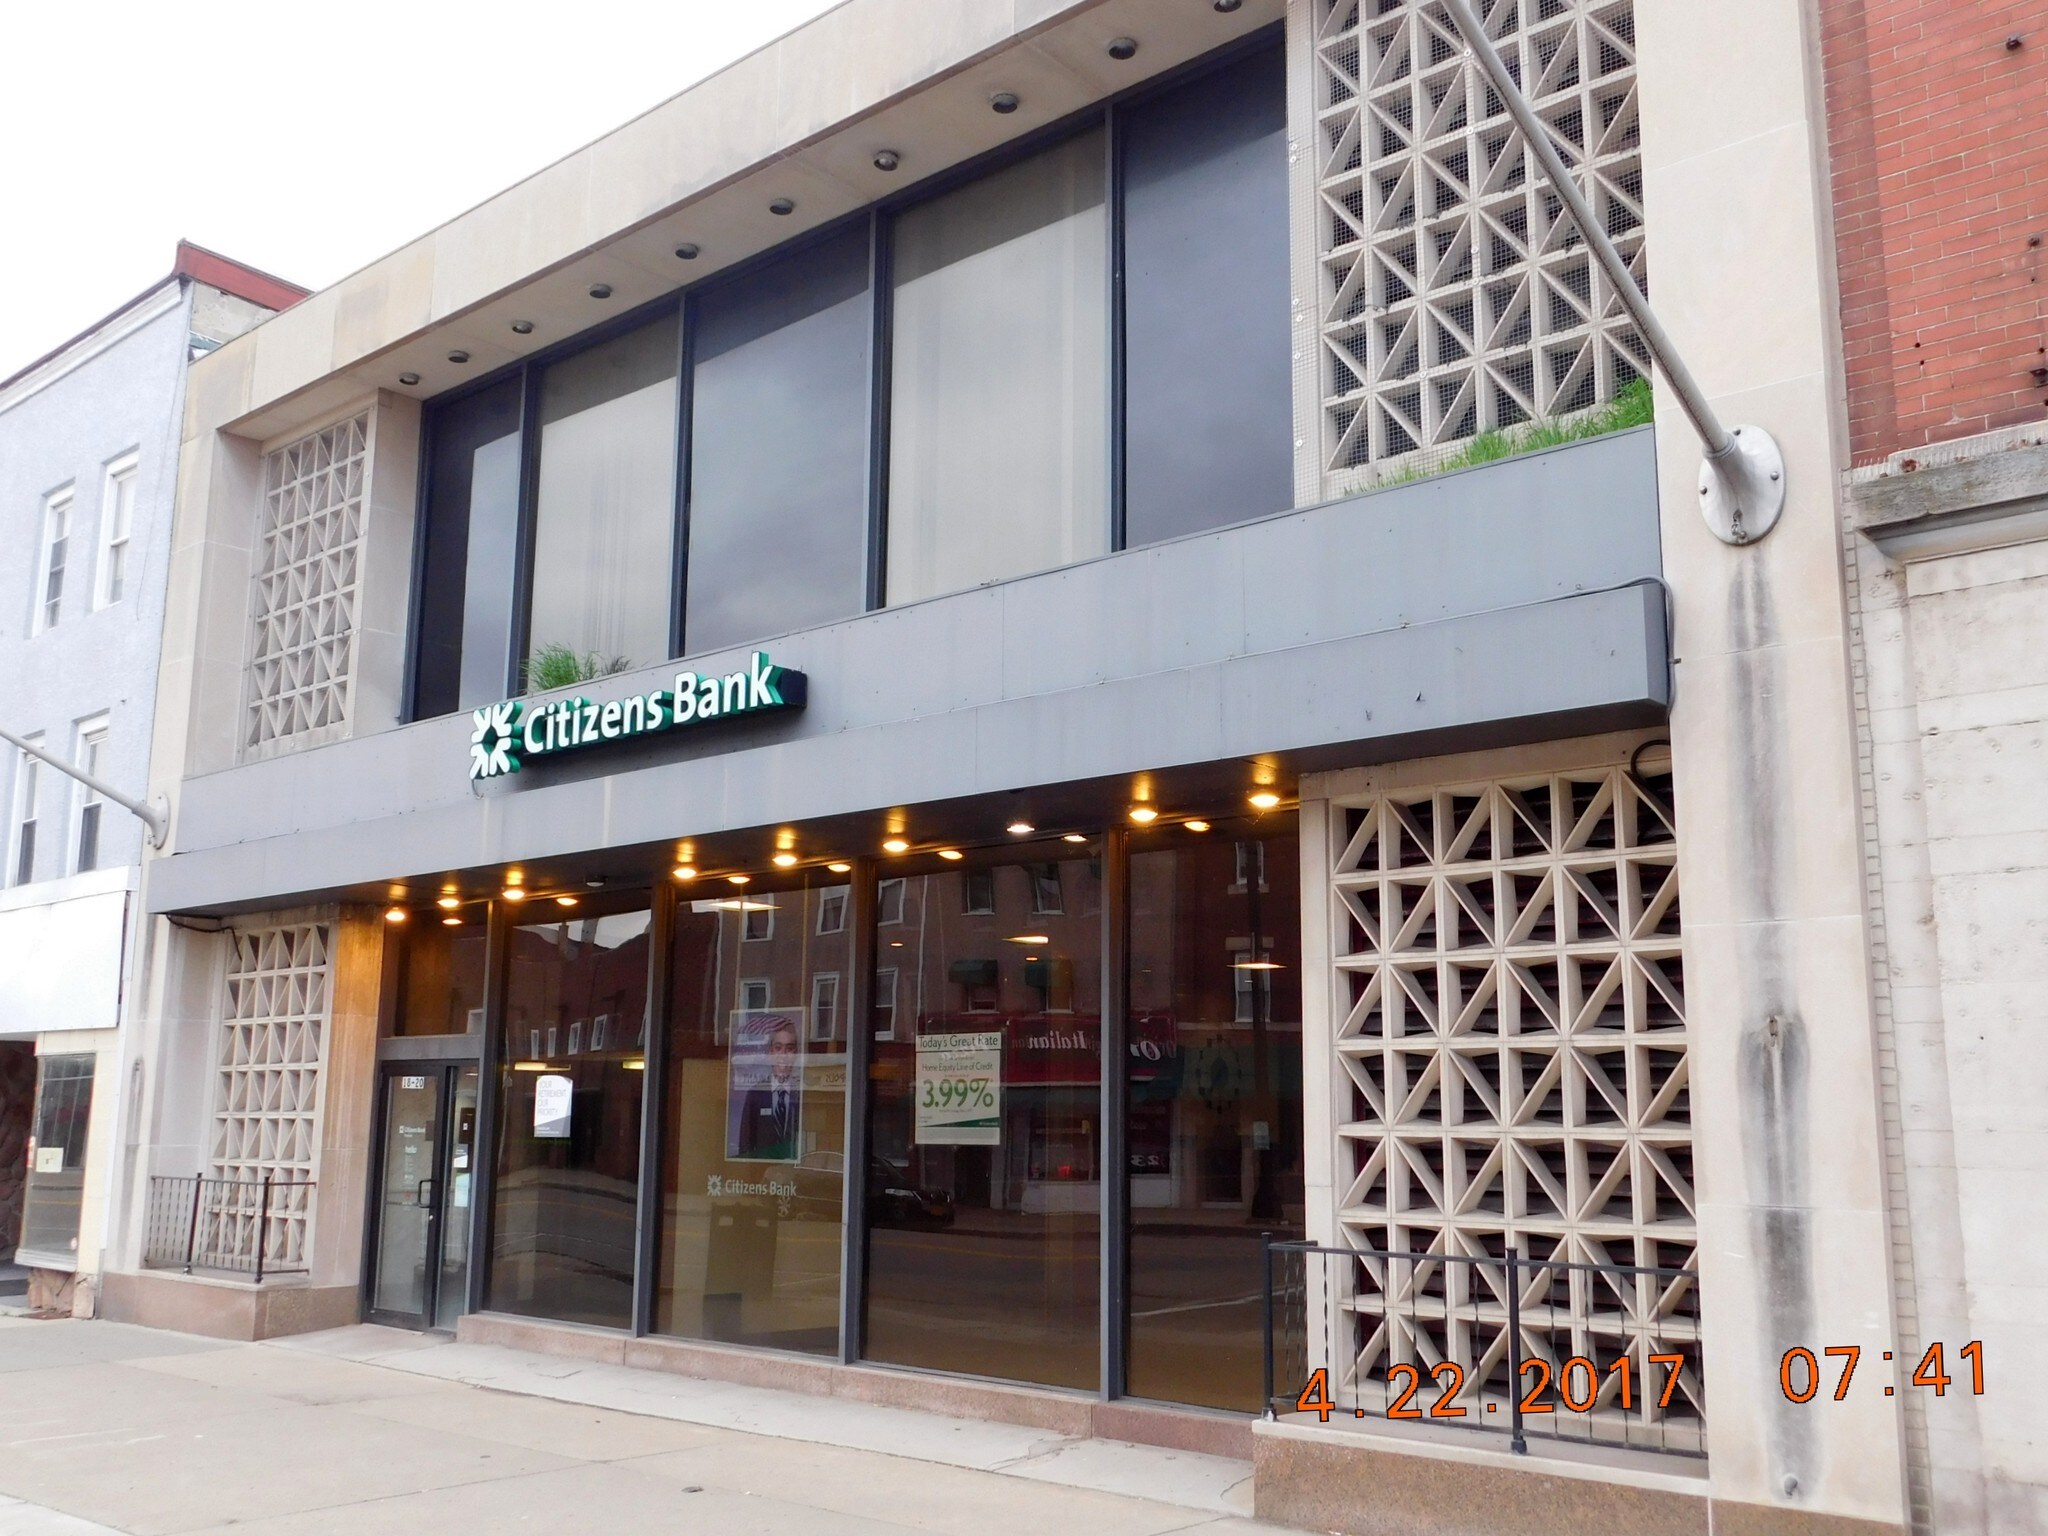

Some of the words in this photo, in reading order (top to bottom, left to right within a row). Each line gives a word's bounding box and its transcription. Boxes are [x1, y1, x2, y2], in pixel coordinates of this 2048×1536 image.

[523, 690, 664, 755] Citizens
[673, 650, 774, 725] Bank
[918, 1036, 948, 1049] Today's
[949, 1035, 975, 1048] Great
[978, 1034, 999, 1047] Rate
[921, 1063, 937, 1072] Home
[938, 1062, 956, 1072] Equity
[956, 1061, 969, 1071] Line
[968, 1061, 976, 1071] of
[975, 1061, 993, 1071] Credit
[403, 1076, 425, 1088] 18-20
[922, 1077, 994, 1108] 3.99%
[725, 1179, 768, 1195] Citizens
[769, 1181, 797, 1197] Bank
